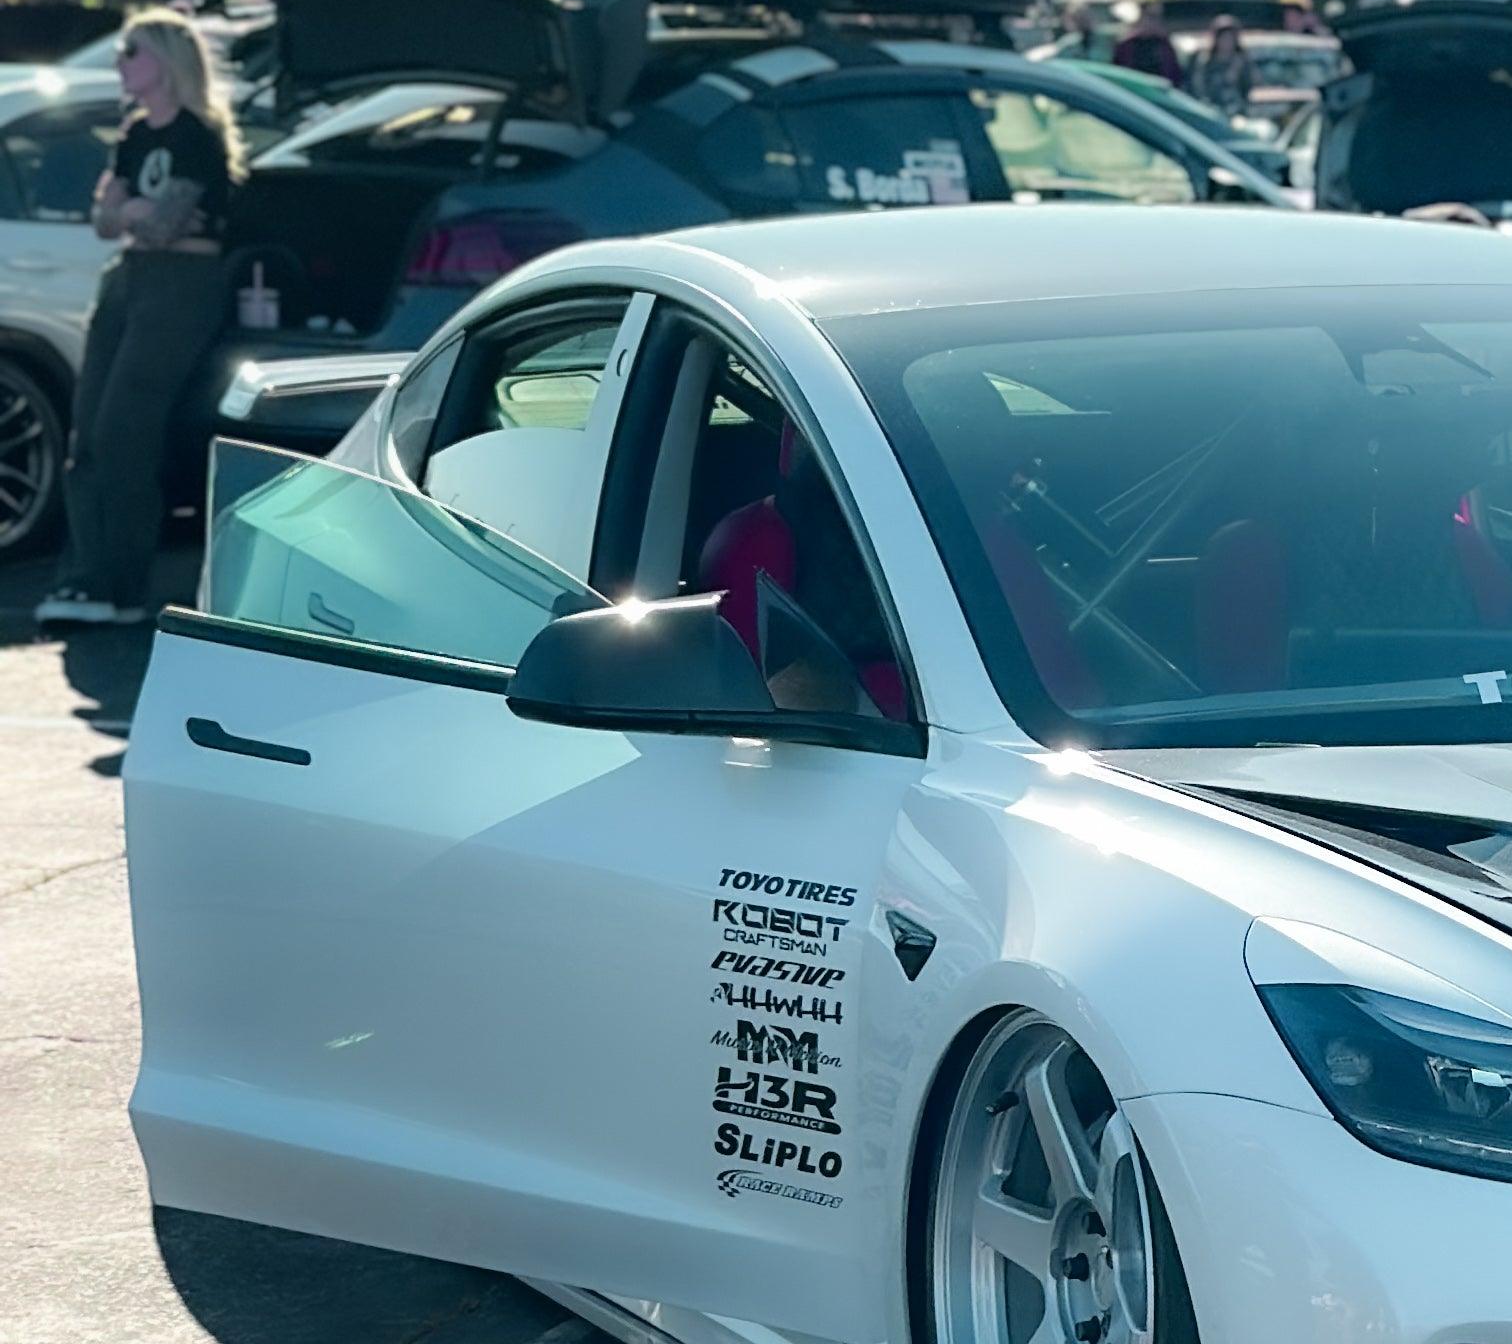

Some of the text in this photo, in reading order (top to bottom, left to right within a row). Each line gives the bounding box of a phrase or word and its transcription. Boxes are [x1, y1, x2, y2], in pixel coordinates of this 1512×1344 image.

[718, 868, 858, 907] TOYO TIRES
[723, 927, 827, 957] CRAFTSMAN
[729, 1103, 825, 1130] PERFORMANCE
